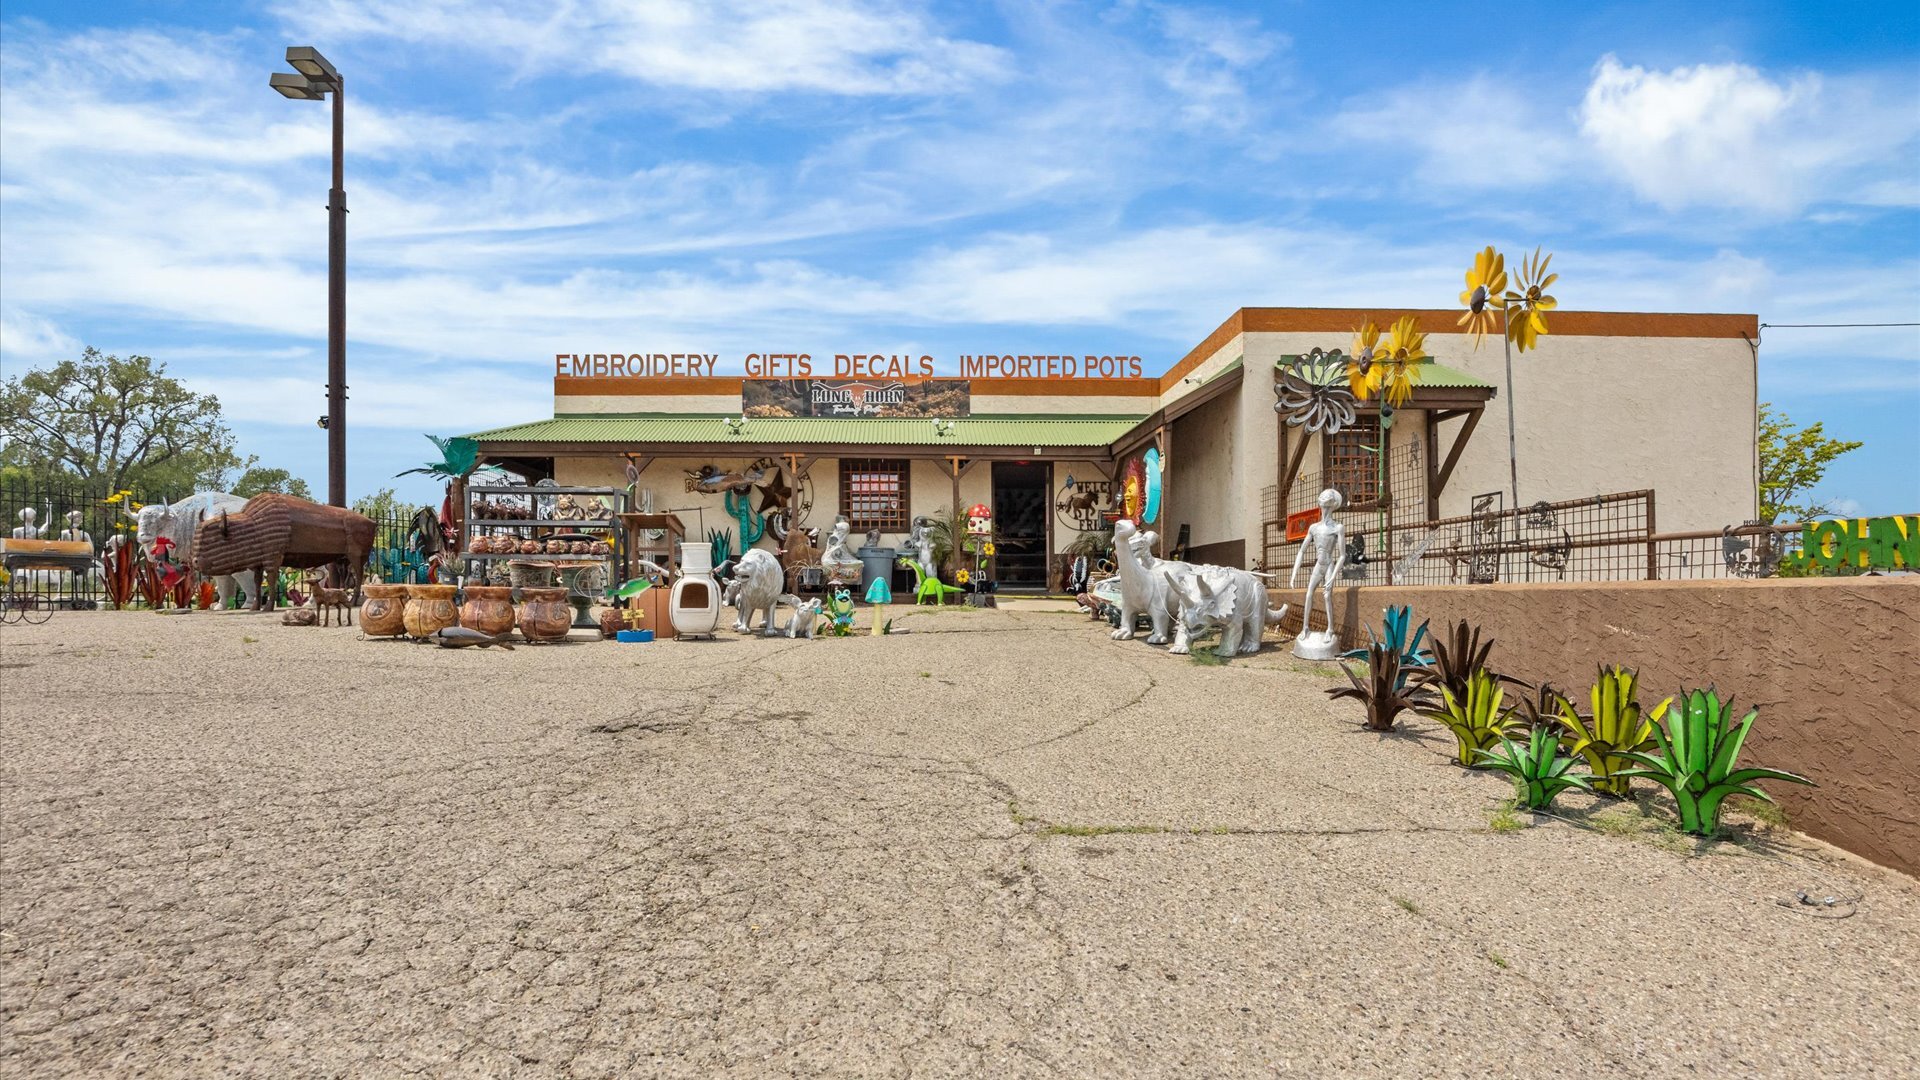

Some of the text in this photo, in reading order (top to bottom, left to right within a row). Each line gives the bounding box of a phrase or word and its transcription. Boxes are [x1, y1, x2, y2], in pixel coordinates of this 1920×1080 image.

[556, 354, 1142, 378] EMBROIDERY GIFTS DECALS IMPORTED POTS
[812, 390, 904, 403] LONG HORN
[1790, 516, 1919, 569] JOHN
